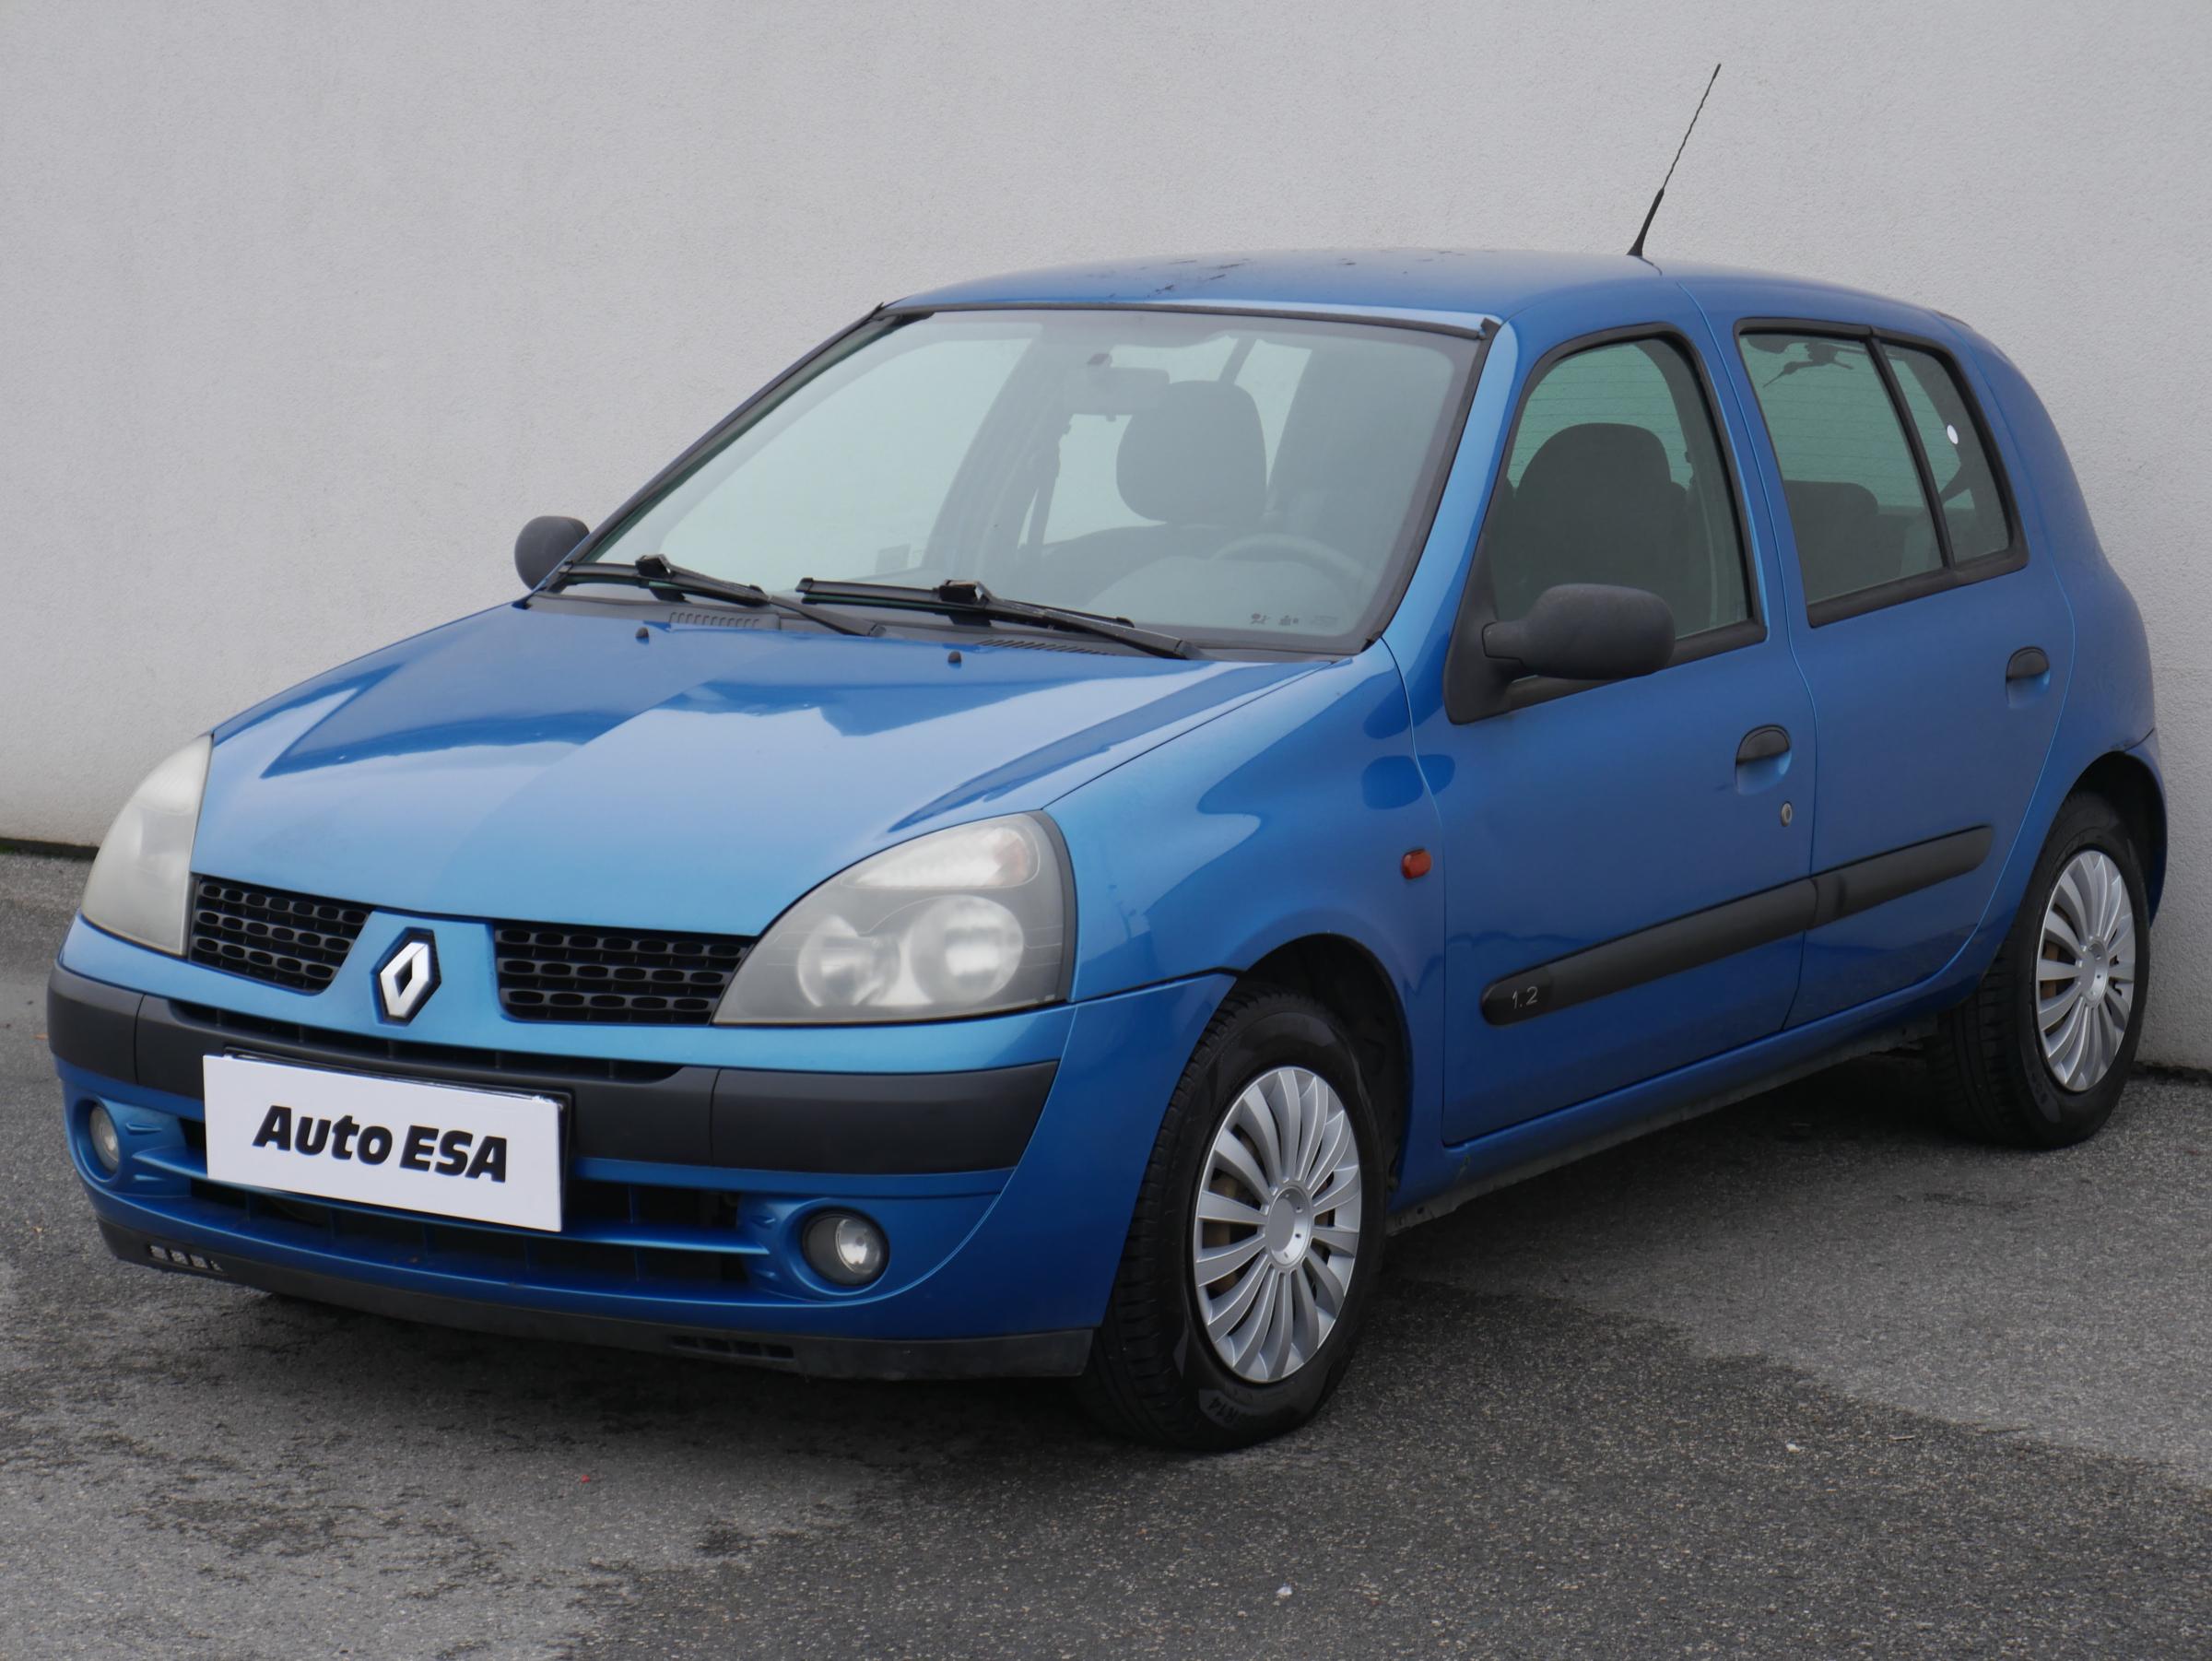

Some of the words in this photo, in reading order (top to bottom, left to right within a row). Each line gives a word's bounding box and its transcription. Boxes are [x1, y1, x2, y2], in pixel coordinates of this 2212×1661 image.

[1512, 985, 1538, 1009] 1.2
[252, 1104, 393, 1165] Auto
[399, 1124, 508, 1184] ESA
